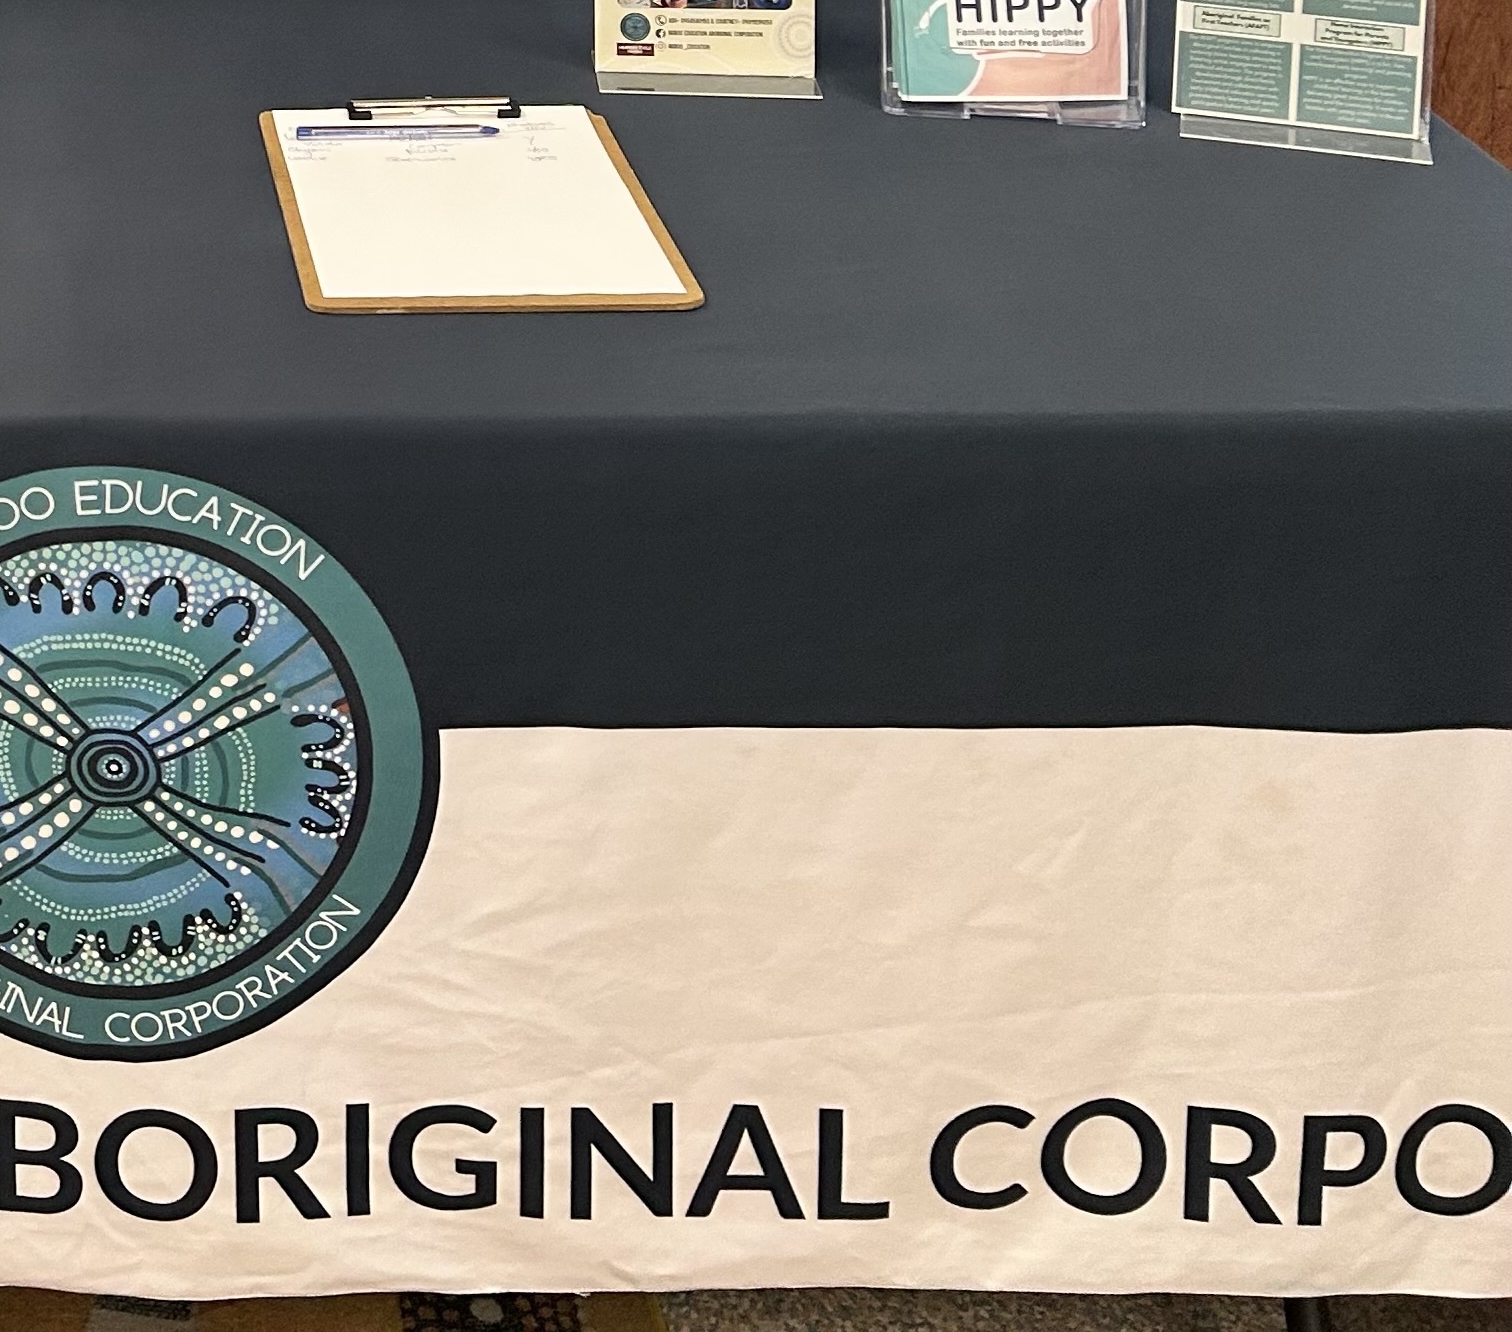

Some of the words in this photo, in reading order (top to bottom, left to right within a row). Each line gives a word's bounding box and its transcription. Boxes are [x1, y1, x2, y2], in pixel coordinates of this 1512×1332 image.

[956, 28, 997, 36] Families
[998, 28, 1040, 37] learning
[1041, 28, 1085, 37] together
[73, 479, 326, 582] EDUCATION
[104, 893, 362, 1044] CORPORATION
[929, 1097, 1512, 1227] CORPO
